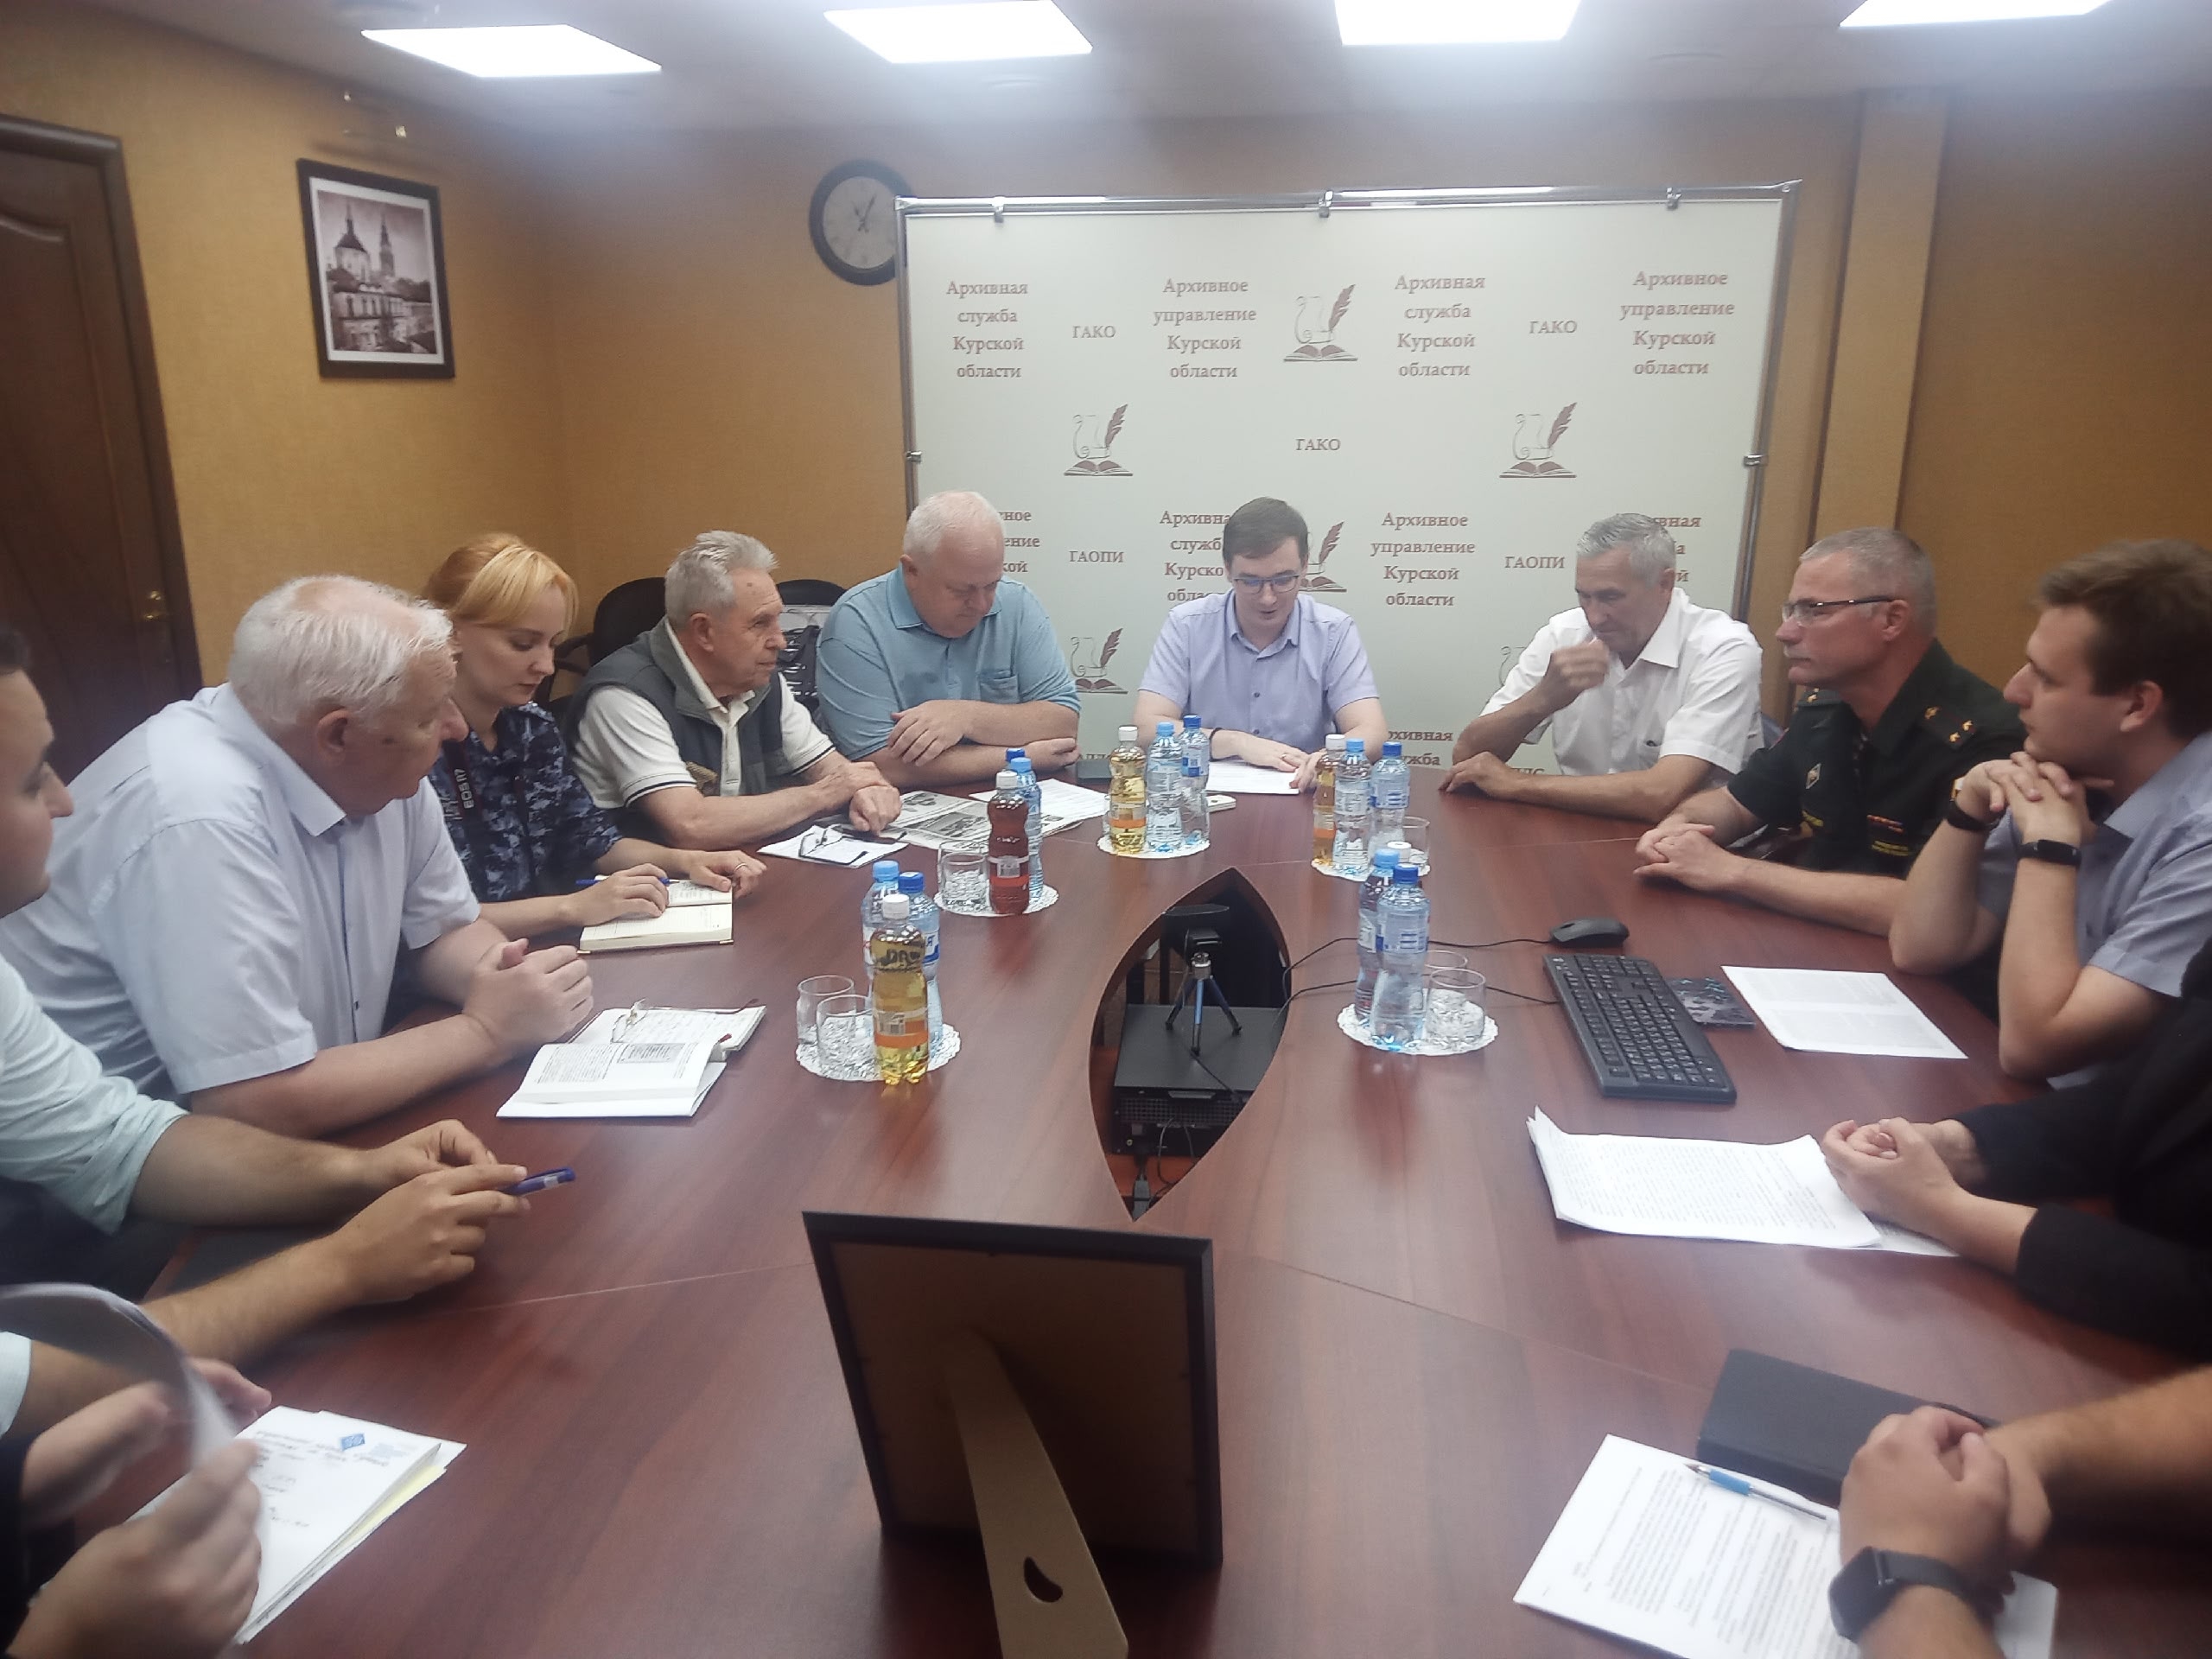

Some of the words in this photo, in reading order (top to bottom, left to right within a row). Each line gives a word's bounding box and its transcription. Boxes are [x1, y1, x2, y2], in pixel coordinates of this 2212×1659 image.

[1162, 277, 1249, 297] Архивное
[1395, 275, 1485, 295] Архивная
[1632, 271, 1728, 290] Архивное
[946, 280, 1028, 299] Архивная
[957, 308, 1018, 327] служба
[1154, 308, 1257, 327] управление
[1404, 303, 1471, 323] служба
[1619, 303, 1735, 321] управление
[1072, 325, 1116, 339] ГАКО
[1529, 321, 1578, 334] ГАКО
[952, 335, 1025, 355] Курской
[1166, 334, 1242, 354] Курской
[1397, 333, 1477, 353] Курской
[1633, 330, 1716, 351] Курской
[957, 364, 1022, 378] области
[1170, 363, 1238, 378] области
[1399, 361, 1471, 377] области
[1634, 359, 1710, 376] области
[1296, 438, 1342, 451] ГАКО
[1160, 511, 1230, 527] Архивна
[1381, 512, 1469, 531] Архивное
[1171, 537, 1222, 554] служб
[1370, 541, 1476, 558] управление
[1069, 550, 1124, 563] ГАОПИ
[1504, 556, 1566, 569] ГАОПИ
[1165, 563, 1224, 580] Курско
[1383, 565, 1459, 584] Курской
[1167, 588, 1220, 601] обла
[1386, 592, 1455, 607] области
